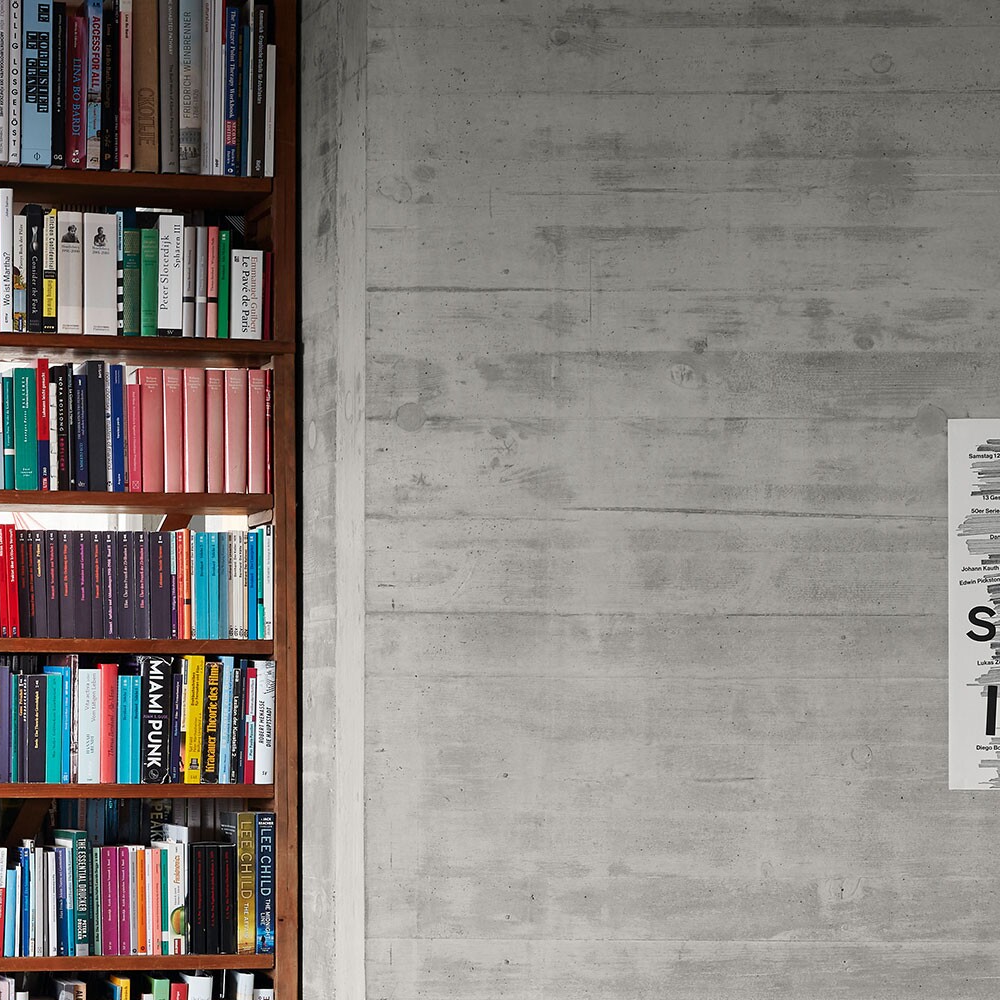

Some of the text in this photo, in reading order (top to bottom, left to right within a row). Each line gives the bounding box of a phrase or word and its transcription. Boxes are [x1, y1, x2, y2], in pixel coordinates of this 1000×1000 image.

[27, 32, 37, 103] LE GRAND
[38, 5, 48, 112] LE CORBUSIER
[91, 16, 101, 88] ACCESS FOR ALL
[183, 12, 192, 119] FRIEDRICH WEINBRENNER
[2, 252, 10, 283] Martha?
[159, 235, 170, 310] Peter Sloterdijk
[173, 236, 182, 268] Sphären
[2, 294, 10, 306] Wo
[968, 453, 993, 461] Samstag
[966, 605, 996, 642] S
[146, 659, 164, 767] MIAMI PUNK
[205, 664, 219, 773] Kracauer Theorie des Films
[76, 838, 87, 912] THE ESSENTIAL DRUCKER
[240, 820, 252, 899] LEE CHILD
[260, 827, 271, 896] LEE CHILD
[75, 990, 83, 1000] ALL
